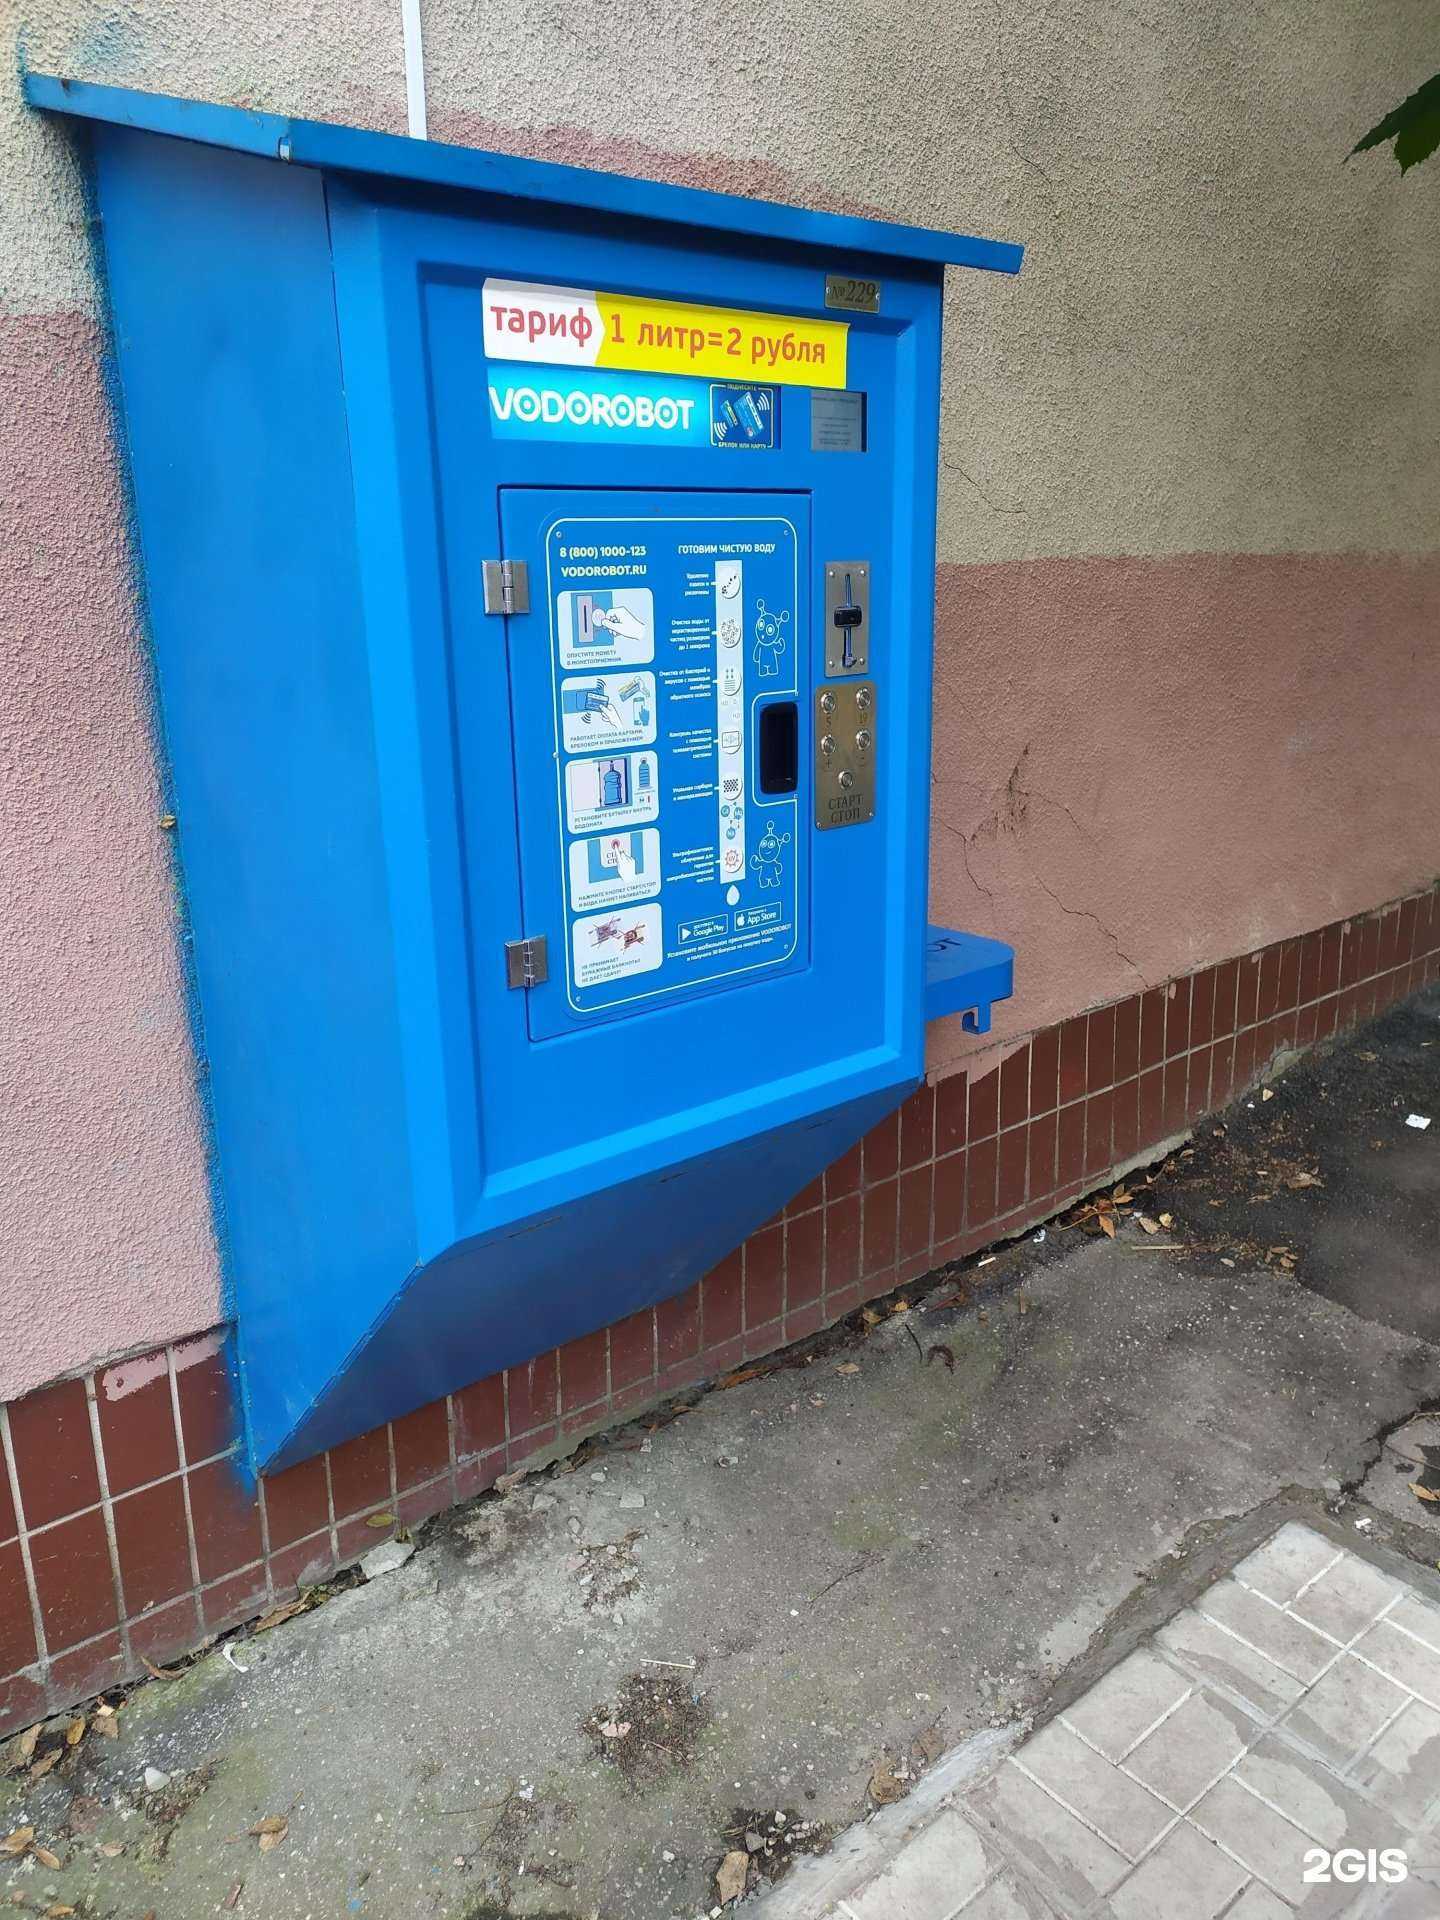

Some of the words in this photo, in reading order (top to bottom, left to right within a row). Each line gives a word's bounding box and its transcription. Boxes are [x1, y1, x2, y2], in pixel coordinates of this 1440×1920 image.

[490, 303, 593, 347] тариф
[610, 313, 625, 343] 1
[638, 320, 742, 358] литр=2
[751, 330, 826, 365] рубля
[488, 385, 695, 429] VODOROBOT
[559, 546, 567, 558] 8
[569, 546, 598, 560] (800)
[600, 545, 647, 557] 1000-123
[678, 544, 718, 554] ГОТОВИМ
[719, 543, 752, 553] ЧИСТУЮ
[754, 543, 776, 554] ВОДУ
[560, 565, 647, 577] VODOROBOT.RU
[828, 793, 864, 810] СТАРТ
[831, 808, 861, 824] СТОП
[747, 915, 761, 926] App
[761, 911, 777, 920] Store
[693, 927, 713, 937] Google
[713, 924, 725, 933] Play
